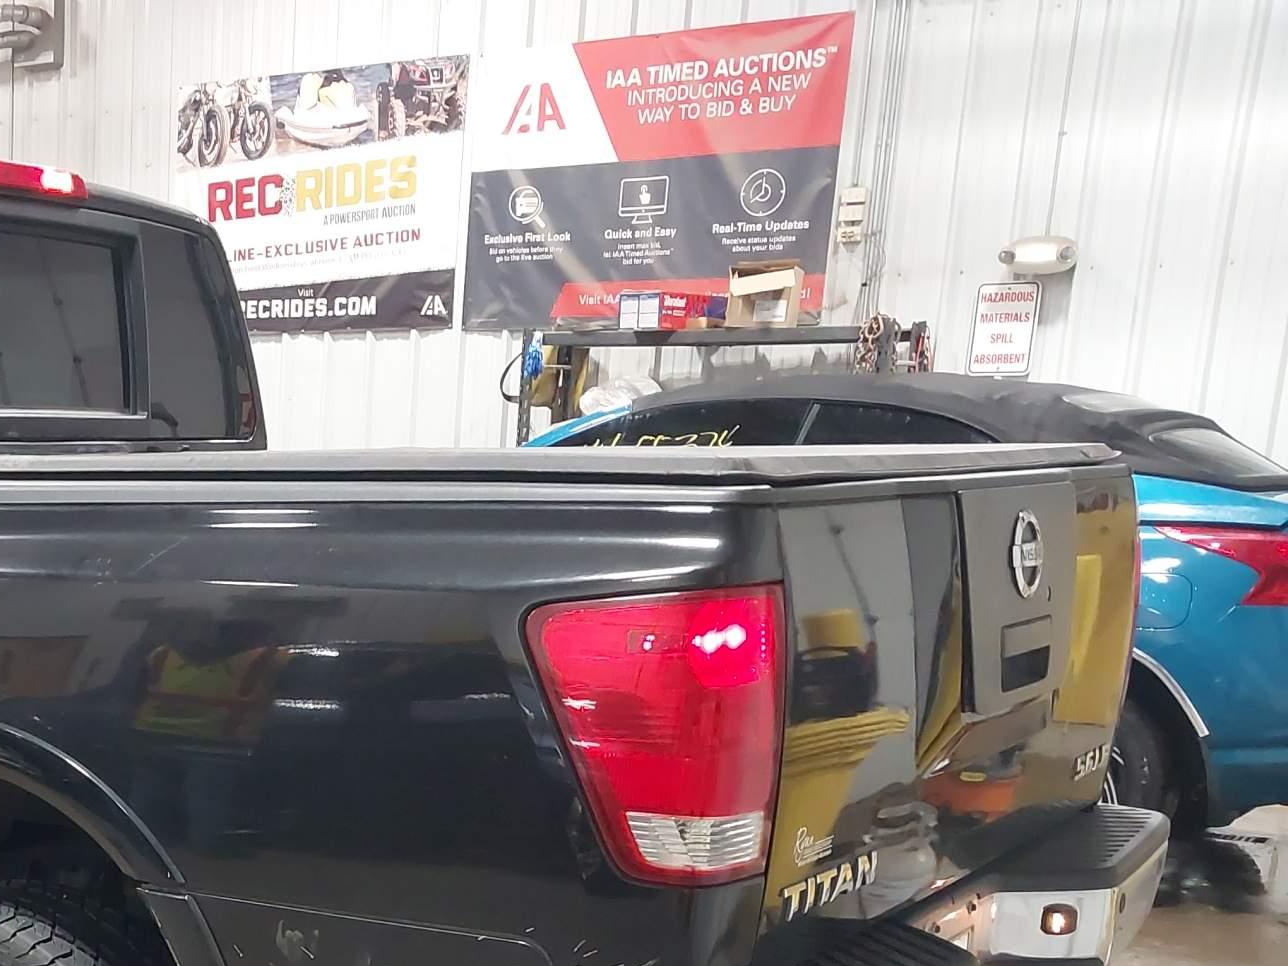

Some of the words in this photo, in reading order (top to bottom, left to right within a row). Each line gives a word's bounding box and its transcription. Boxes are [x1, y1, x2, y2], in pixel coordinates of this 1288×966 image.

[606, 68, 642, 89] IAA
[646, 60, 709, 85] TIMED
[627, 80, 744, 106] INTRODUCING
[748, 78, 762, 94] A
[768, 72, 812, 92] NEW
[638, 105, 674, 125] WAY
[678, 103, 700, 120] TO
[706, 100, 734, 118] BID
[740, 99, 753, 115] &
[759, 94, 796, 113] BUY
[208, 173, 285, 223] REC
[296, 155, 418, 213] RIDES
[323, 215, 329, 226] A
[329, 207, 379, 225] POWERSPORT
[381, 203, 416, 219] AUCTION
[604, 228, 632, 239] Quick
[634, 226, 652, 238] and
[654, 226, 677, 239] Easy
[712, 221, 763, 234] Real-Time
[765, 219, 810, 232] Updates
[484, 232, 523, 245] Exclusive
[525, 232, 545, 243] First
[547, 231, 571, 242] Look
[722, 237, 747, 245] Receive
[747, 236, 768, 244] status
[768, 235, 796, 243] updates
[227, 237, 348, 263] INE-EXCLUSIVE
[353, 228, 422, 249] AUCTION
[732, 245, 751, 253] about
[751, 245, 767, 253] your
[768, 243, 784, 251] bids
[297, 288, 314, 297] Visit
[579, 294, 600, 305] Visit
[981, 290, 1035, 304] HAZARDOUS
[980, 312, 1030, 324] MATERIALS
[990, 332, 1014, 344] SPILL
[973, 352, 1025, 364] ABSORBENT
[783, 850, 878, 923] TITAN
